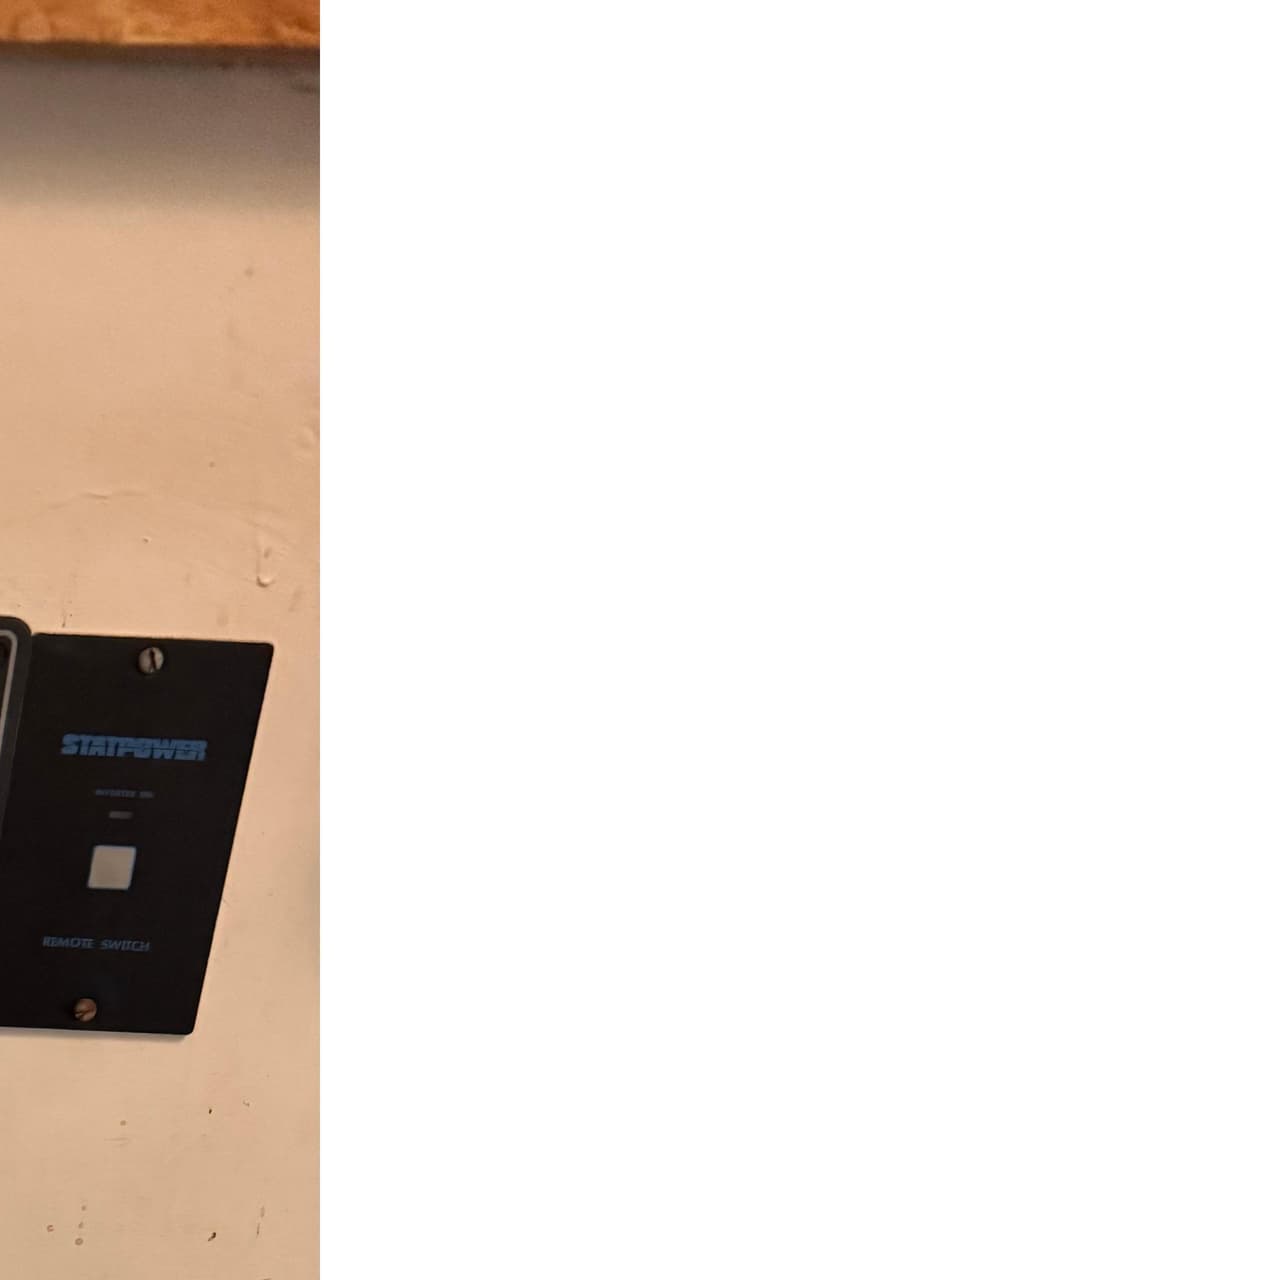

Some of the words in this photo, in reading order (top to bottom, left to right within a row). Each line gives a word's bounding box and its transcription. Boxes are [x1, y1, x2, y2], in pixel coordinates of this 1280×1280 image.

[60, 733, 208, 761] STATPOWER
[42, 935, 96, 949] REMOTE
[100, 938, 151, 952] SWITCH
